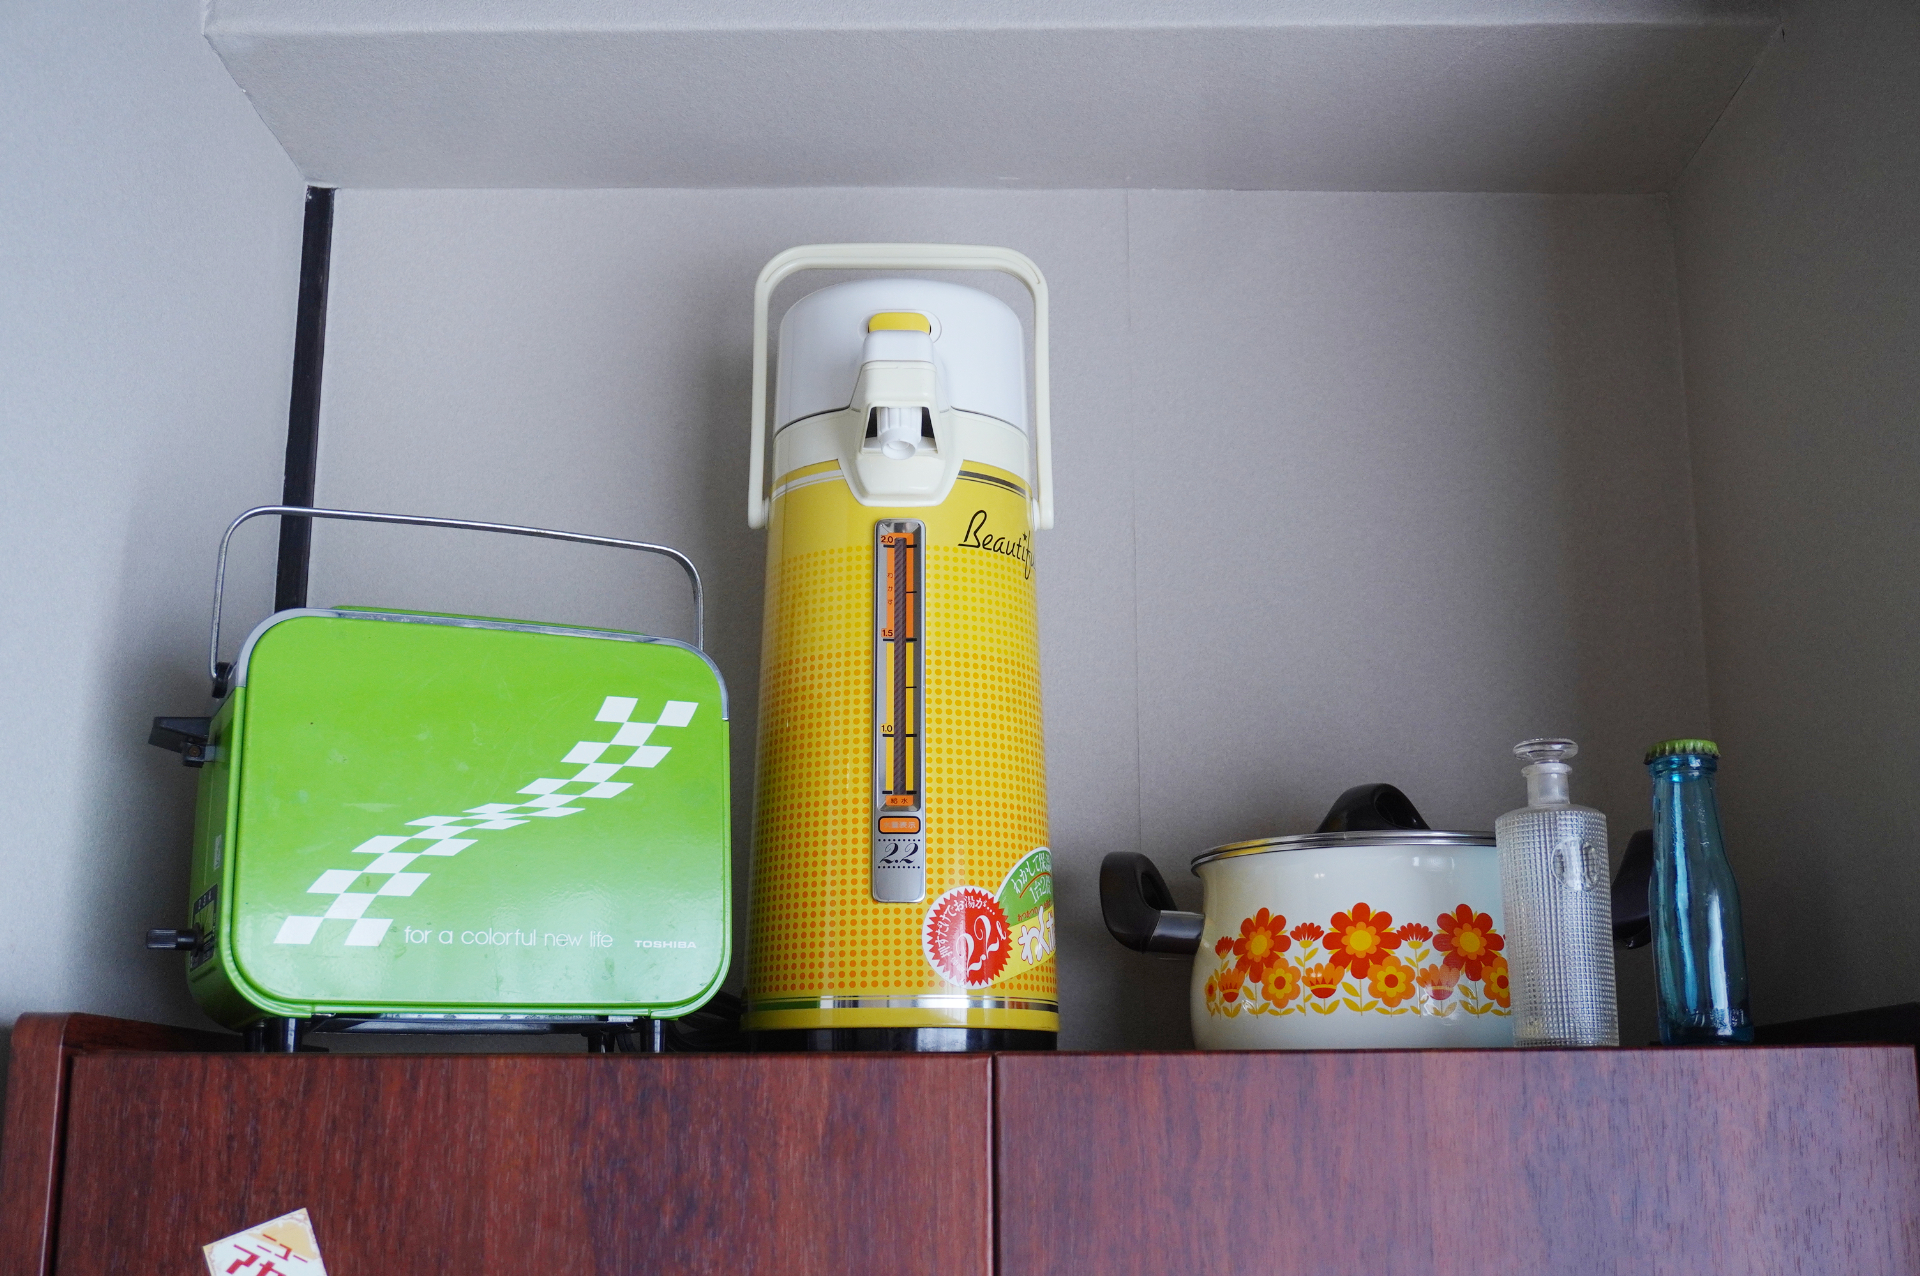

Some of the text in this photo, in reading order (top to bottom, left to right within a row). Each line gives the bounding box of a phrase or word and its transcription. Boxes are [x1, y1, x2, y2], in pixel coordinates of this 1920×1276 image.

[880, 535, 894, 544] 2.0
[882, 629, 893, 637] 1.5
[881, 724, 893, 733] 1.0
[890, 797, 909, 805] 給水
[883, 821, 917, 829] 水量表示
[879, 842, 919, 864] 2.2
[404, 925, 614, 948] for a colorful new life
[634, 940, 697, 949] TOSHIBA
